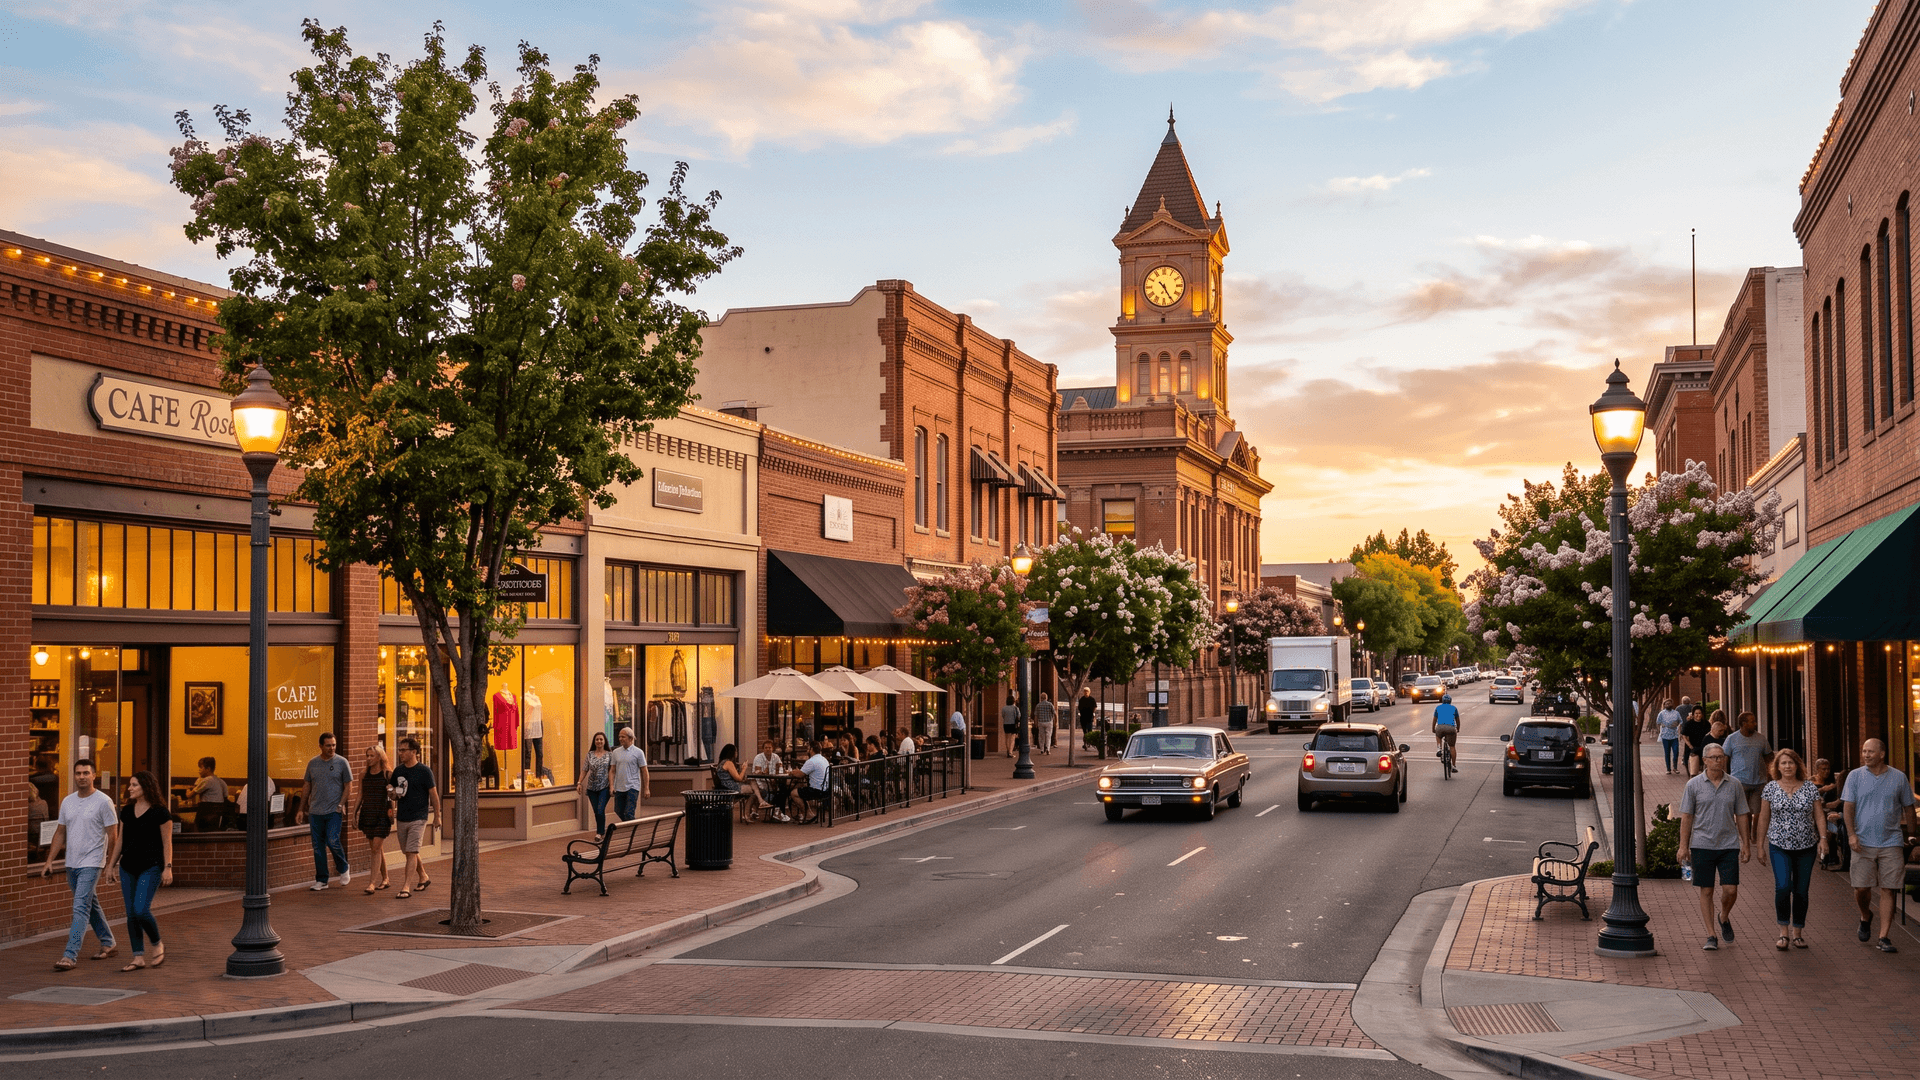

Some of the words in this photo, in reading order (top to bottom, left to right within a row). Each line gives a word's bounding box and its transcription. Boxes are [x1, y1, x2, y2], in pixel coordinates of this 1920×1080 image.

[108, 387, 181, 428] CAFE
[277, 685, 317, 704] CAFE
[274, 705, 319, 721] Roseville
